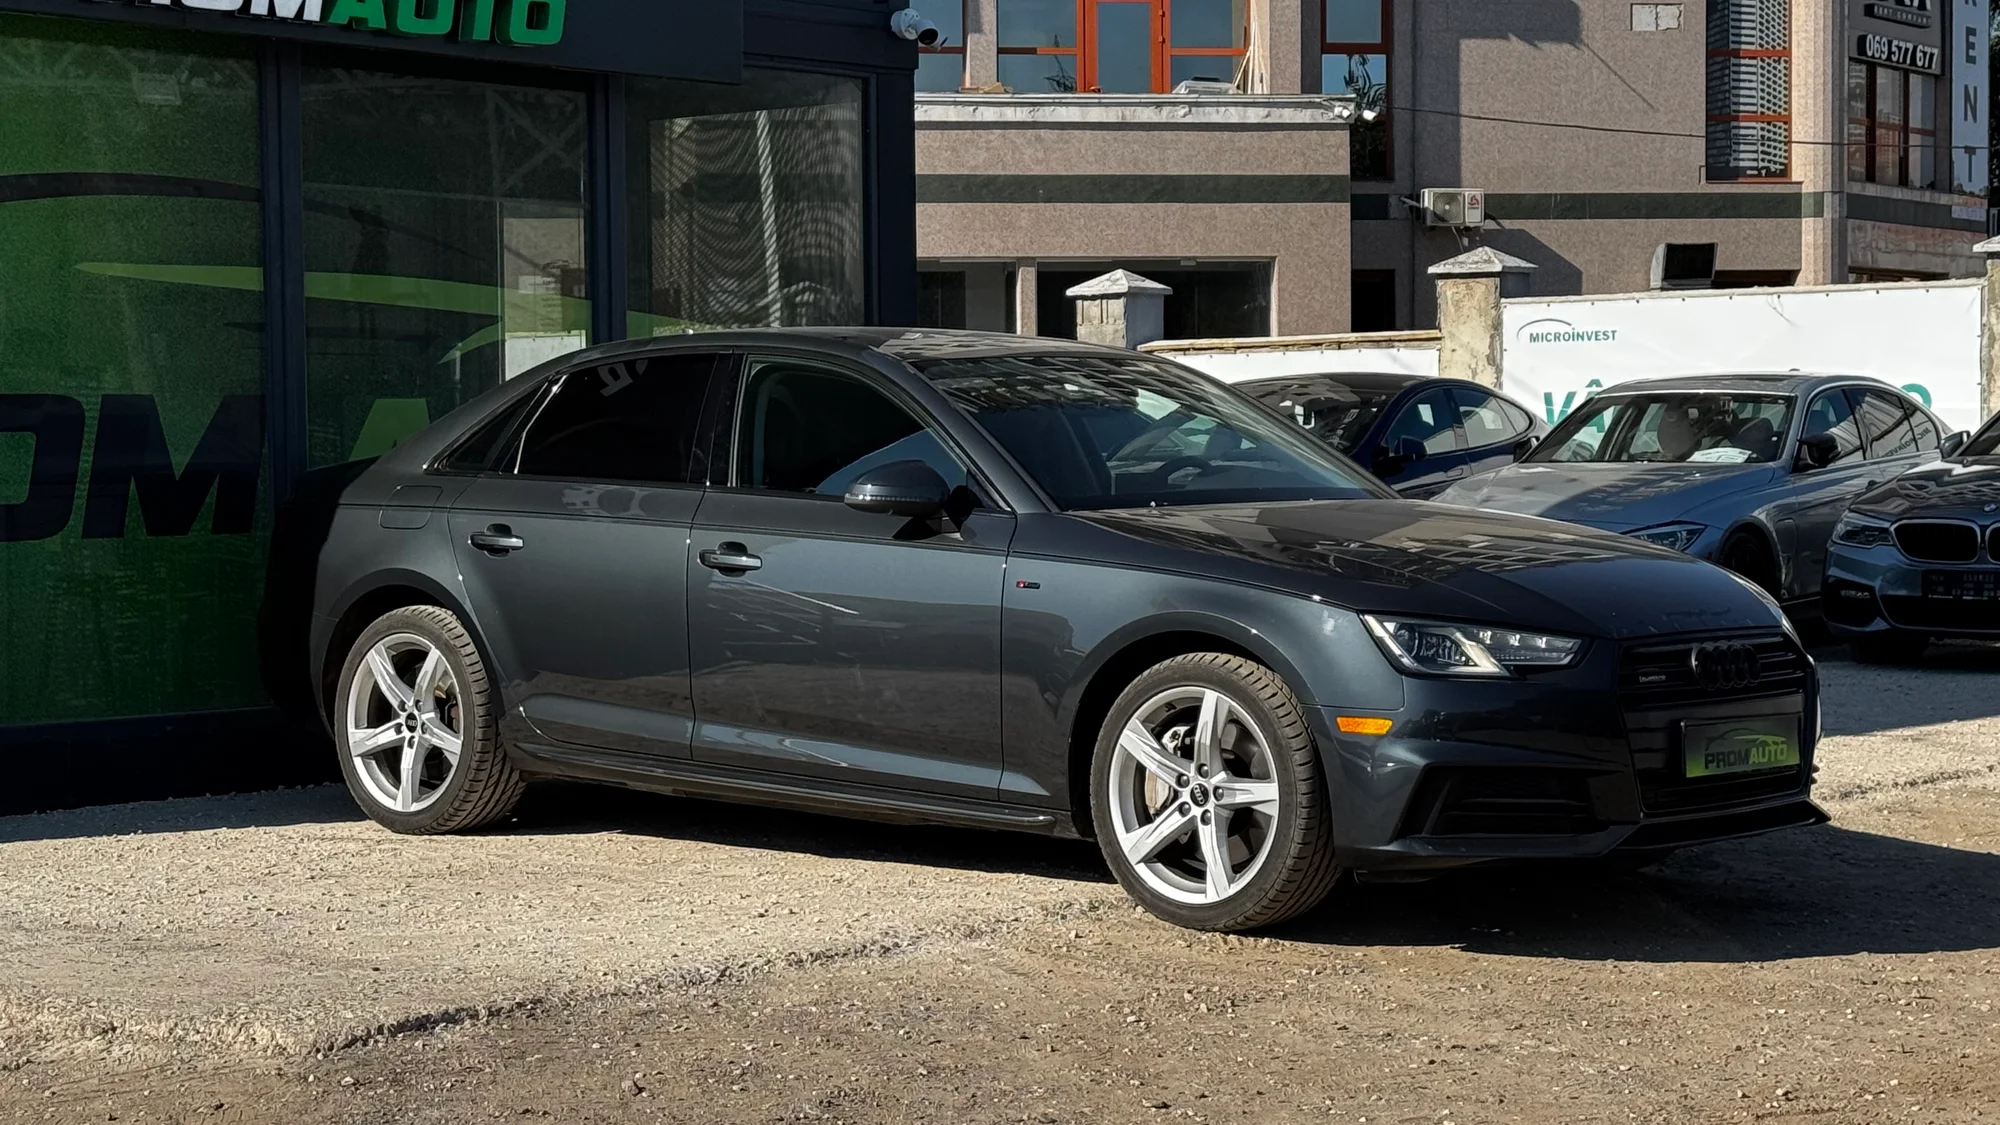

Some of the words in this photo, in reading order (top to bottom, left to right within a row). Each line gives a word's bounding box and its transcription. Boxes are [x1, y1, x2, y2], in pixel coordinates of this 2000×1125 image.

[1866, 33, 1888, 60] 069
[1891, 39, 1914, 65] 577
[1916, 44, 1939, 70] 677
[1963, 0, 1978, 183] ENT
[1705, 744, 1788, 769] PROMAUTO
